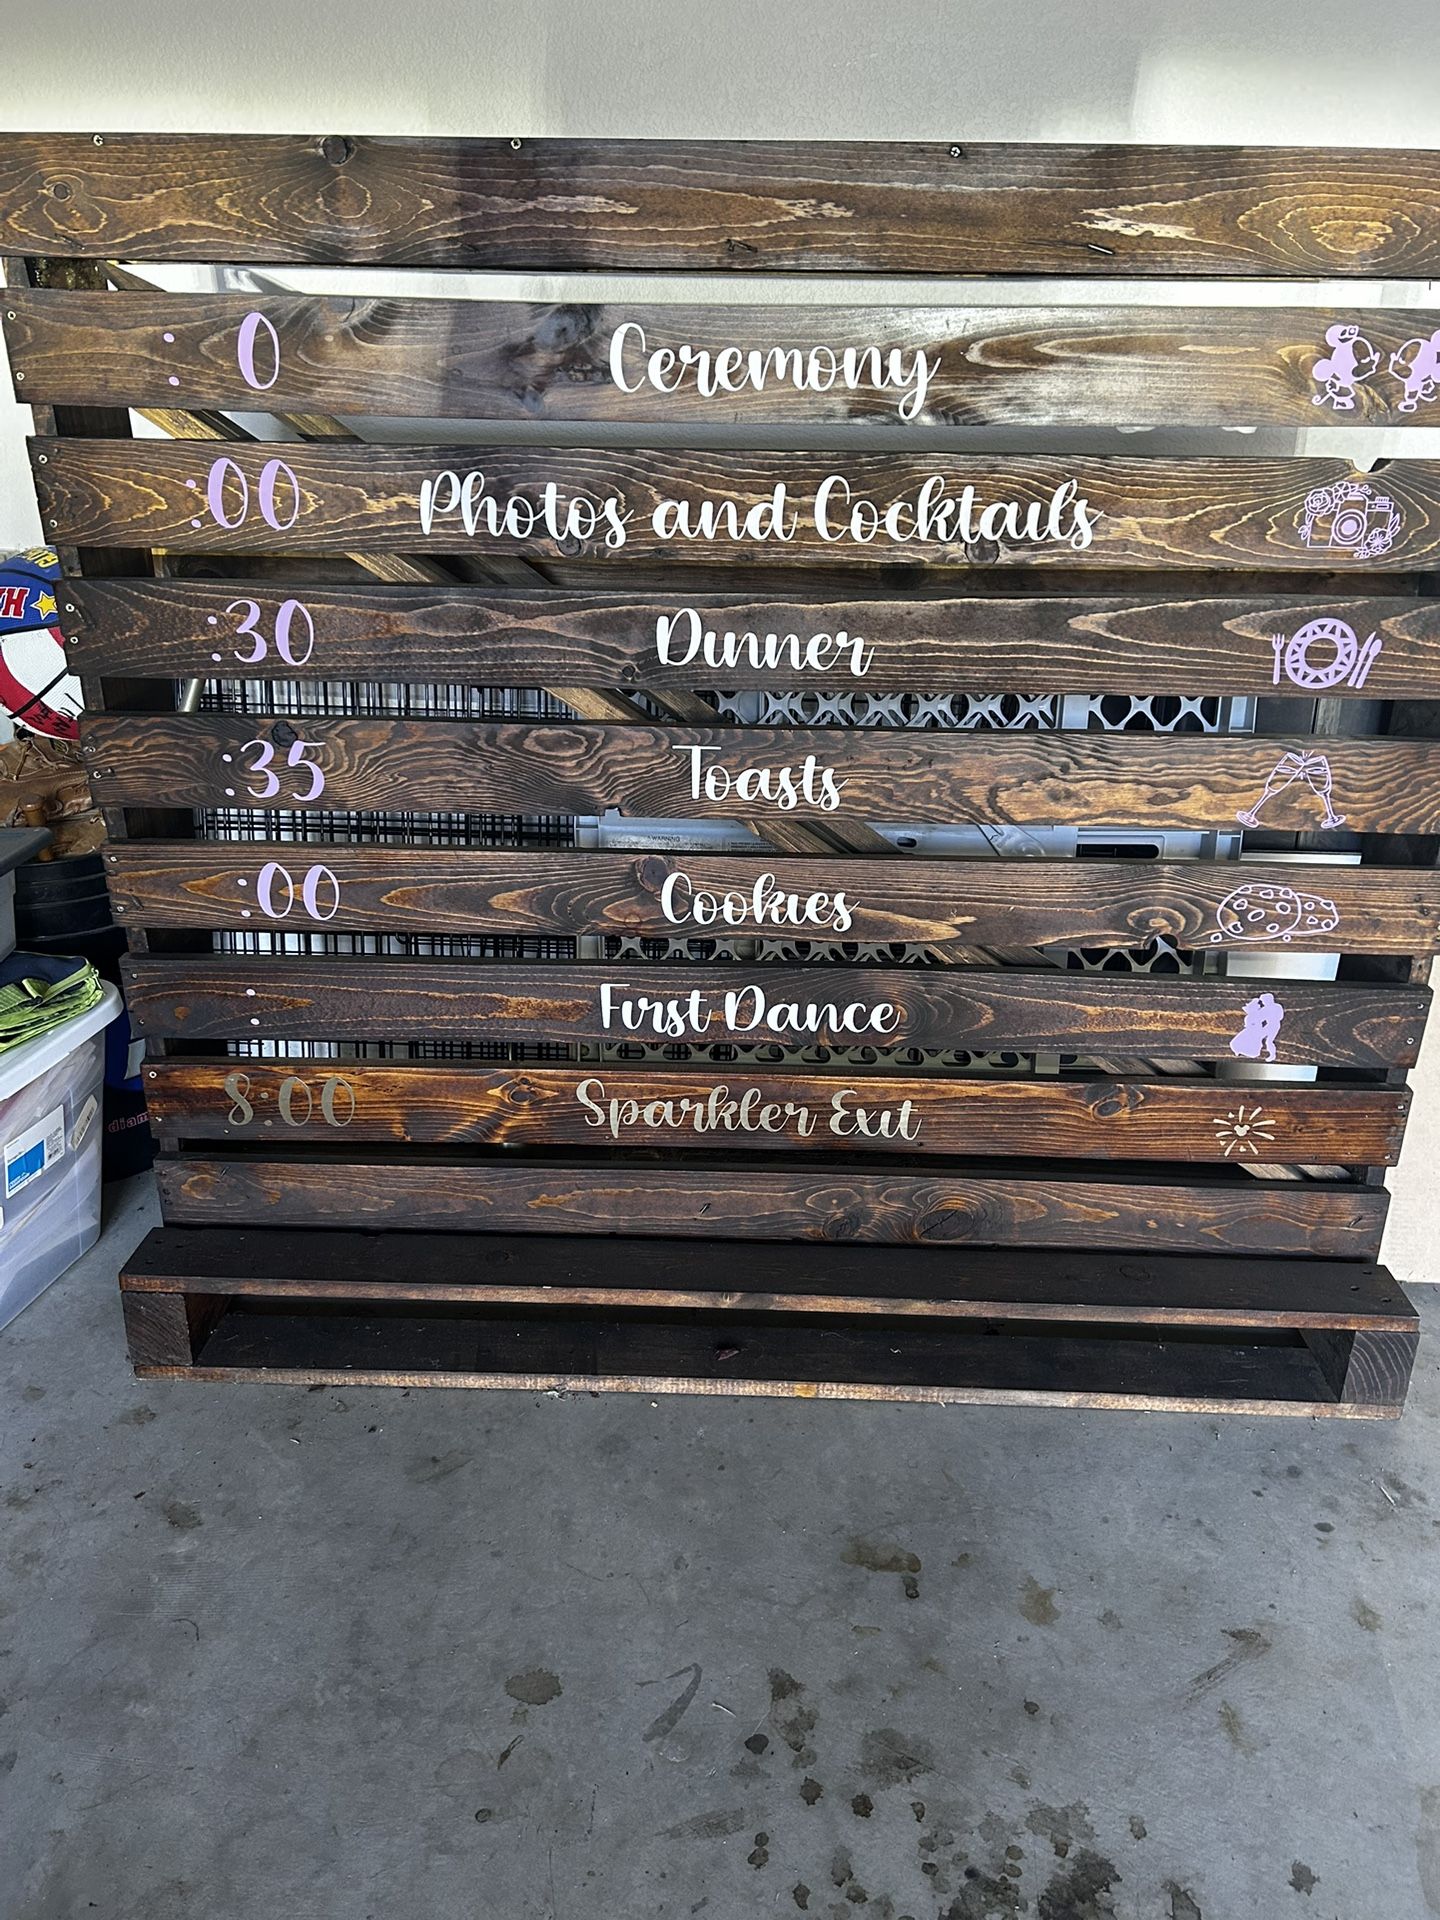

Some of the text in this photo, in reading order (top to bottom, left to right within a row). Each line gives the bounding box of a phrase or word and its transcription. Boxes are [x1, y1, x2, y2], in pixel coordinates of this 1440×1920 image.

[609, 321, 940, 420] Ceremony
[185, 457, 301, 531] :00
[419, 471, 1105, 550] Photos and Cocktails
[207, 599, 315, 667] :30
[656, 607, 875, 677] Dinner
[222, 739, 327, 802] :35
[671, 744, 850, 812] Toasts
[237, 861, 341, 921] :00
[659, 871, 860, 932] Cookies
[600, 983, 901, 1038] First Dance
[224, 1072, 356, 1128] 8:00
[575, 1078, 923, 1141] Sparkler Exit
